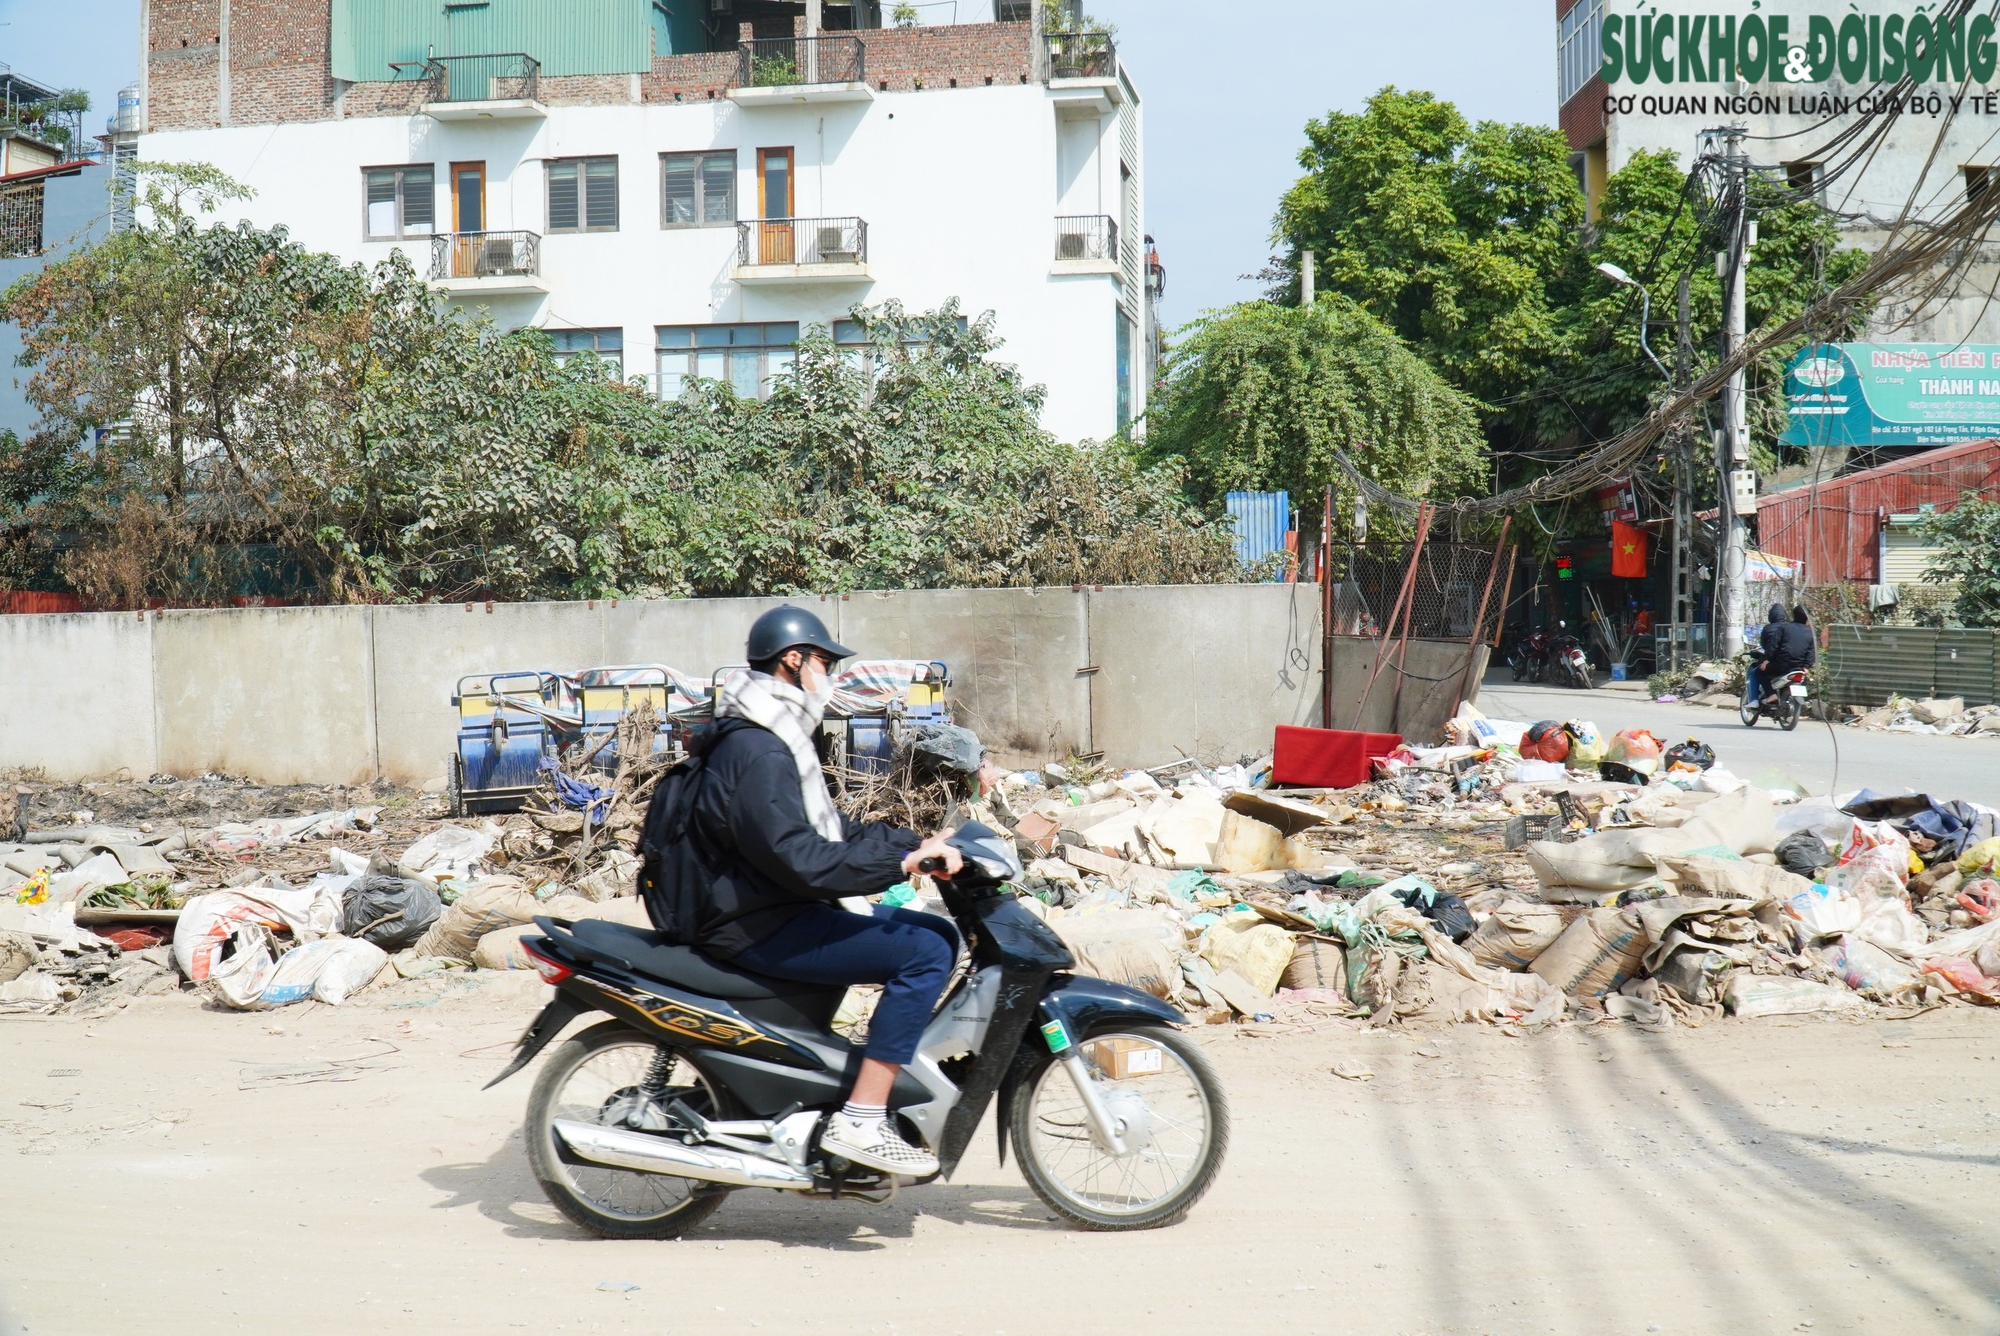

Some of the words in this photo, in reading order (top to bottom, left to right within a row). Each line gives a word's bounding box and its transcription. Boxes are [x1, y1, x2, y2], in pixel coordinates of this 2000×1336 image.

[1872, 349, 1931, 371] NHỰA
[1936, 347, 1985, 368] TIỀN
[1919, 375, 1974, 395] THÀNH
